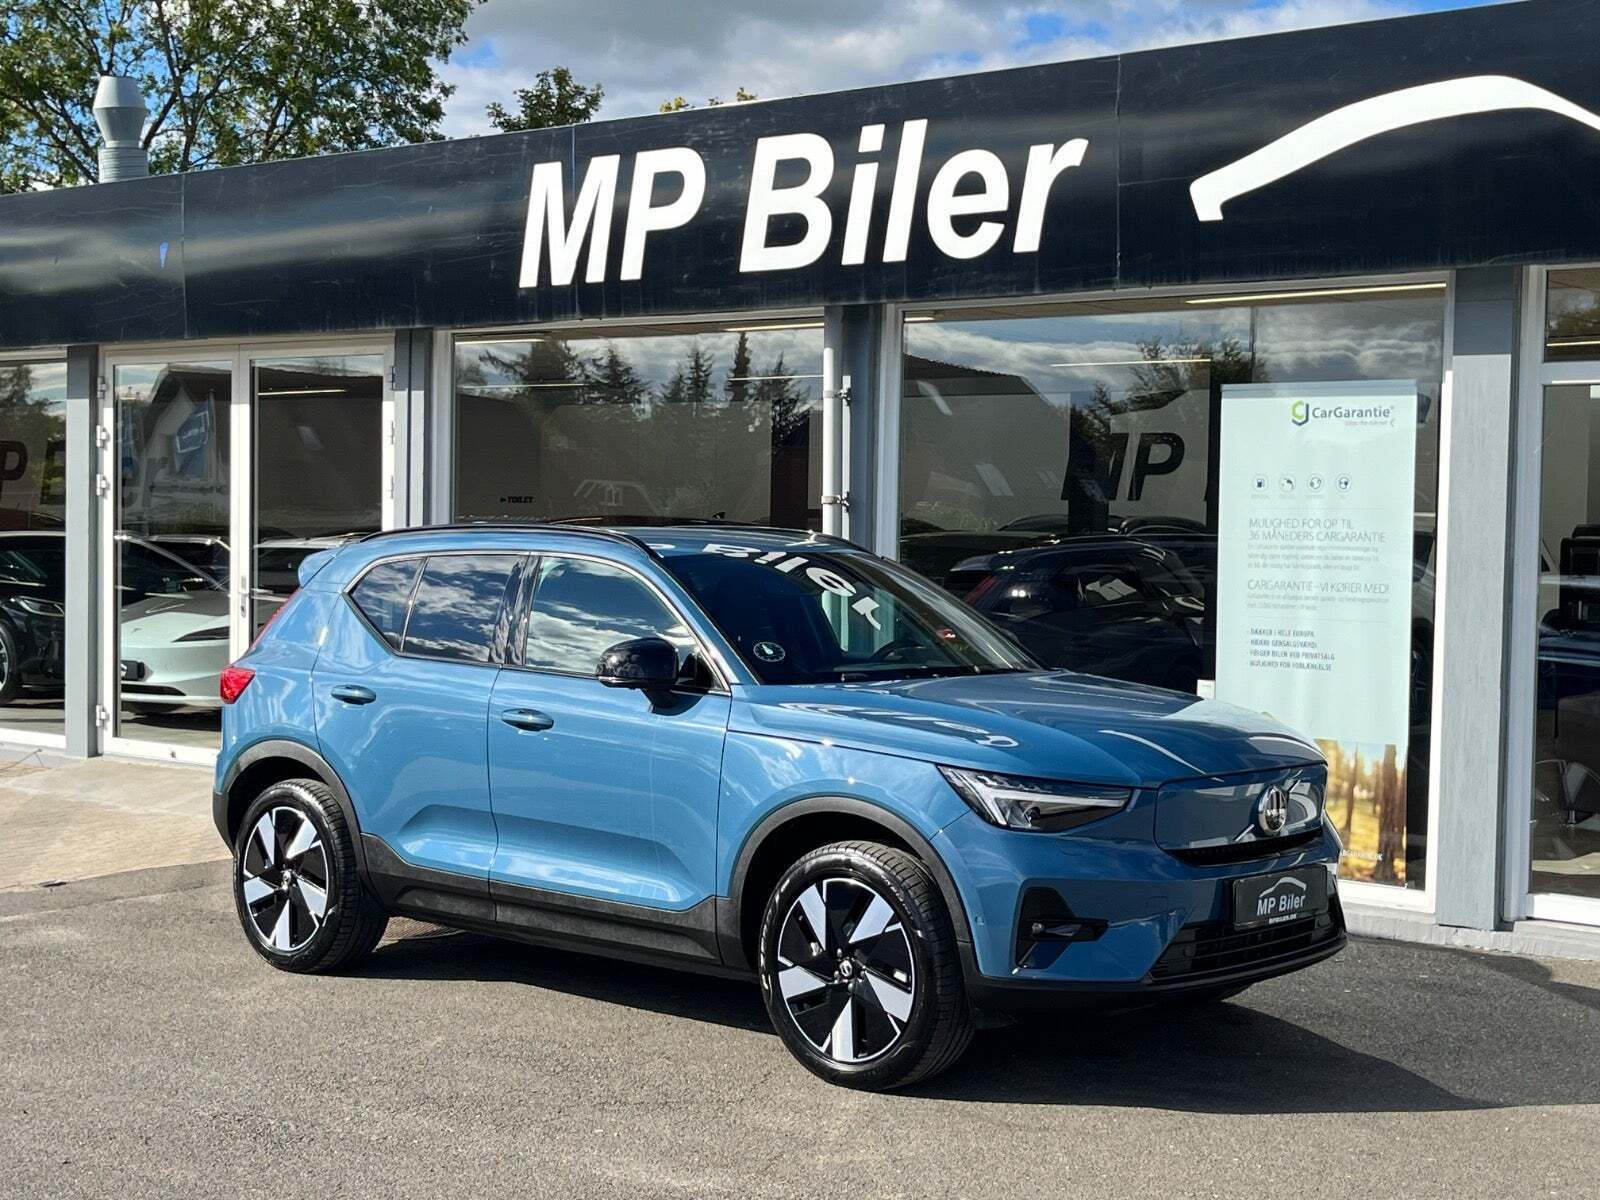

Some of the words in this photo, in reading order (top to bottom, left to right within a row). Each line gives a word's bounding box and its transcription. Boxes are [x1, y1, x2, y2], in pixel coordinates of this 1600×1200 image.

[519, 147, 706, 288] MP
[739, 119, 1089, 273] Biler
[1312, 405, 1391, 419] CarGarantie
[1302, 518, 1321, 529] FOR
[1323, 519, 1338, 529] OP
[1341, 519, 1354, 530] TIL
[1249, 530, 1260, 541] 36
[1316, 531, 1387, 543] CARGARANTIE
[1247, 579, 1313, 592] CARGARANTIE
[1257, 897, 1276, 916] MP
[1278, 894, 1306, 912] Biler
